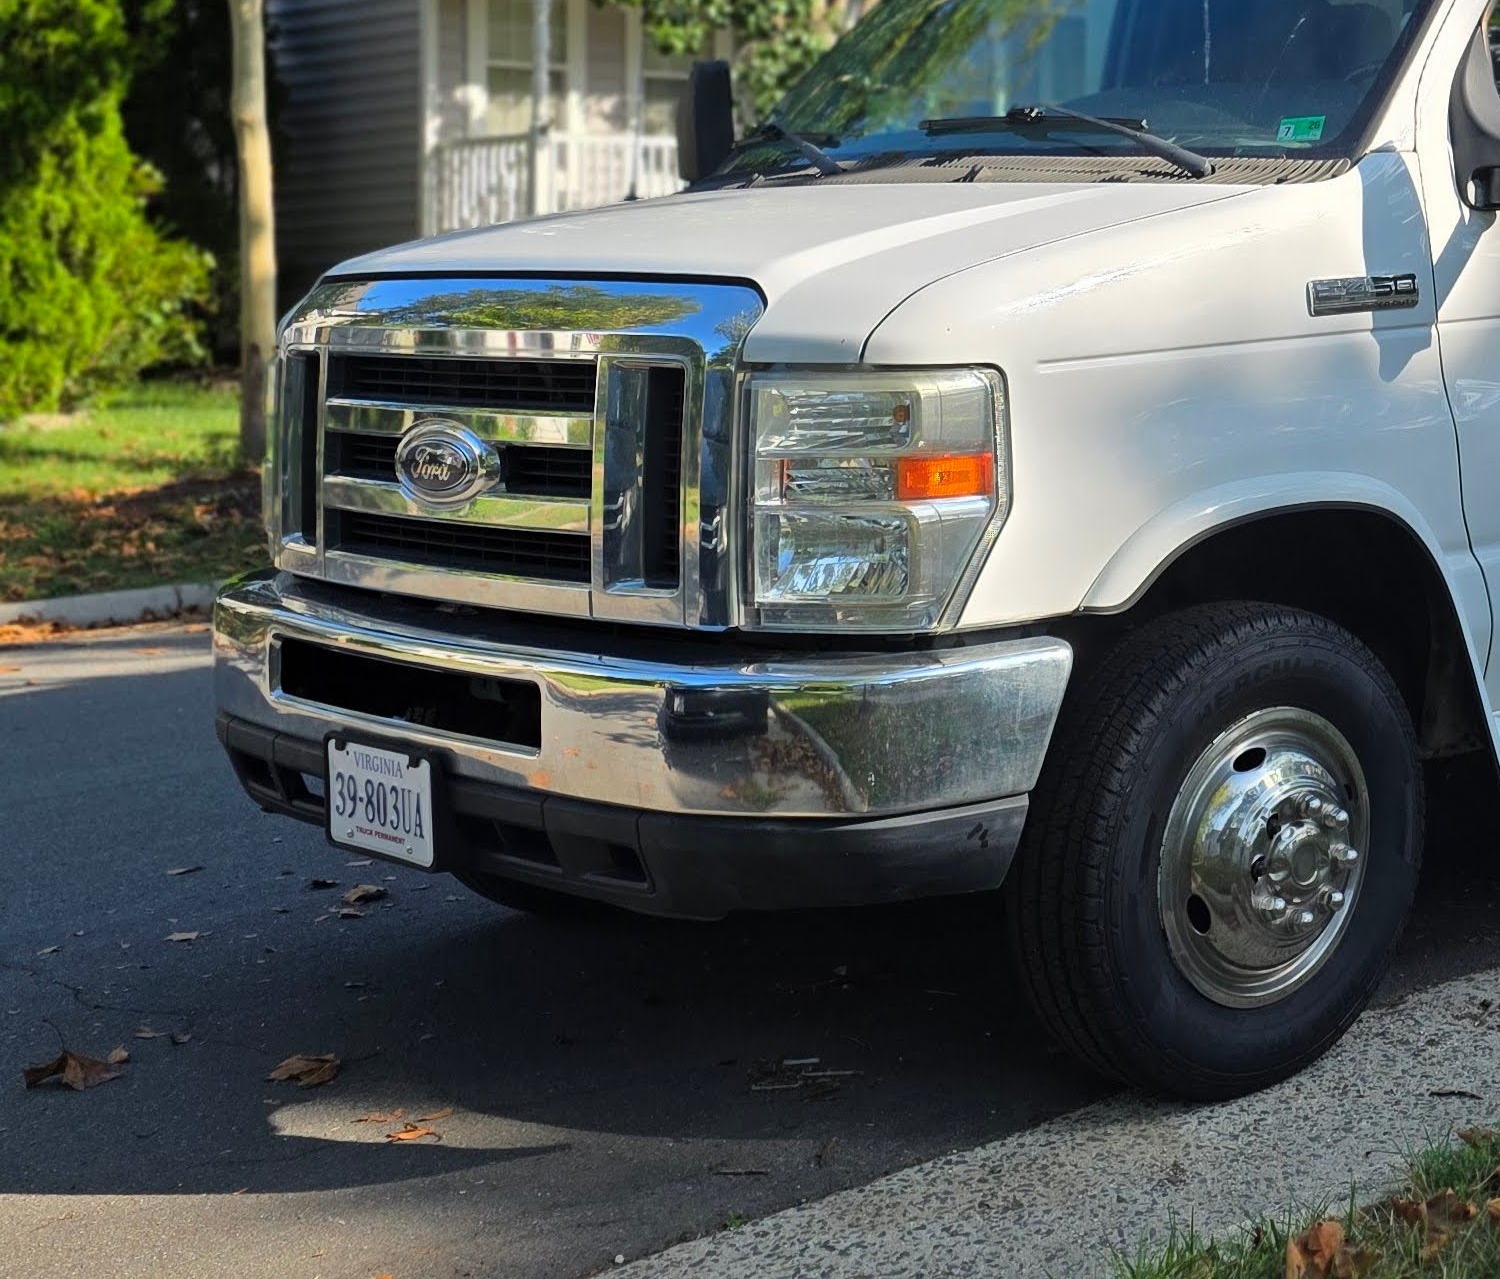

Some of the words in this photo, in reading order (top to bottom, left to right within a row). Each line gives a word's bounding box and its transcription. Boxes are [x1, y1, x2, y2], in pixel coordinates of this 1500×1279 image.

[353, 751, 403, 779] VIRGINIA
[335, 771, 425, 839] 39-803UA
[355, 825, 373, 837] TRUCK
